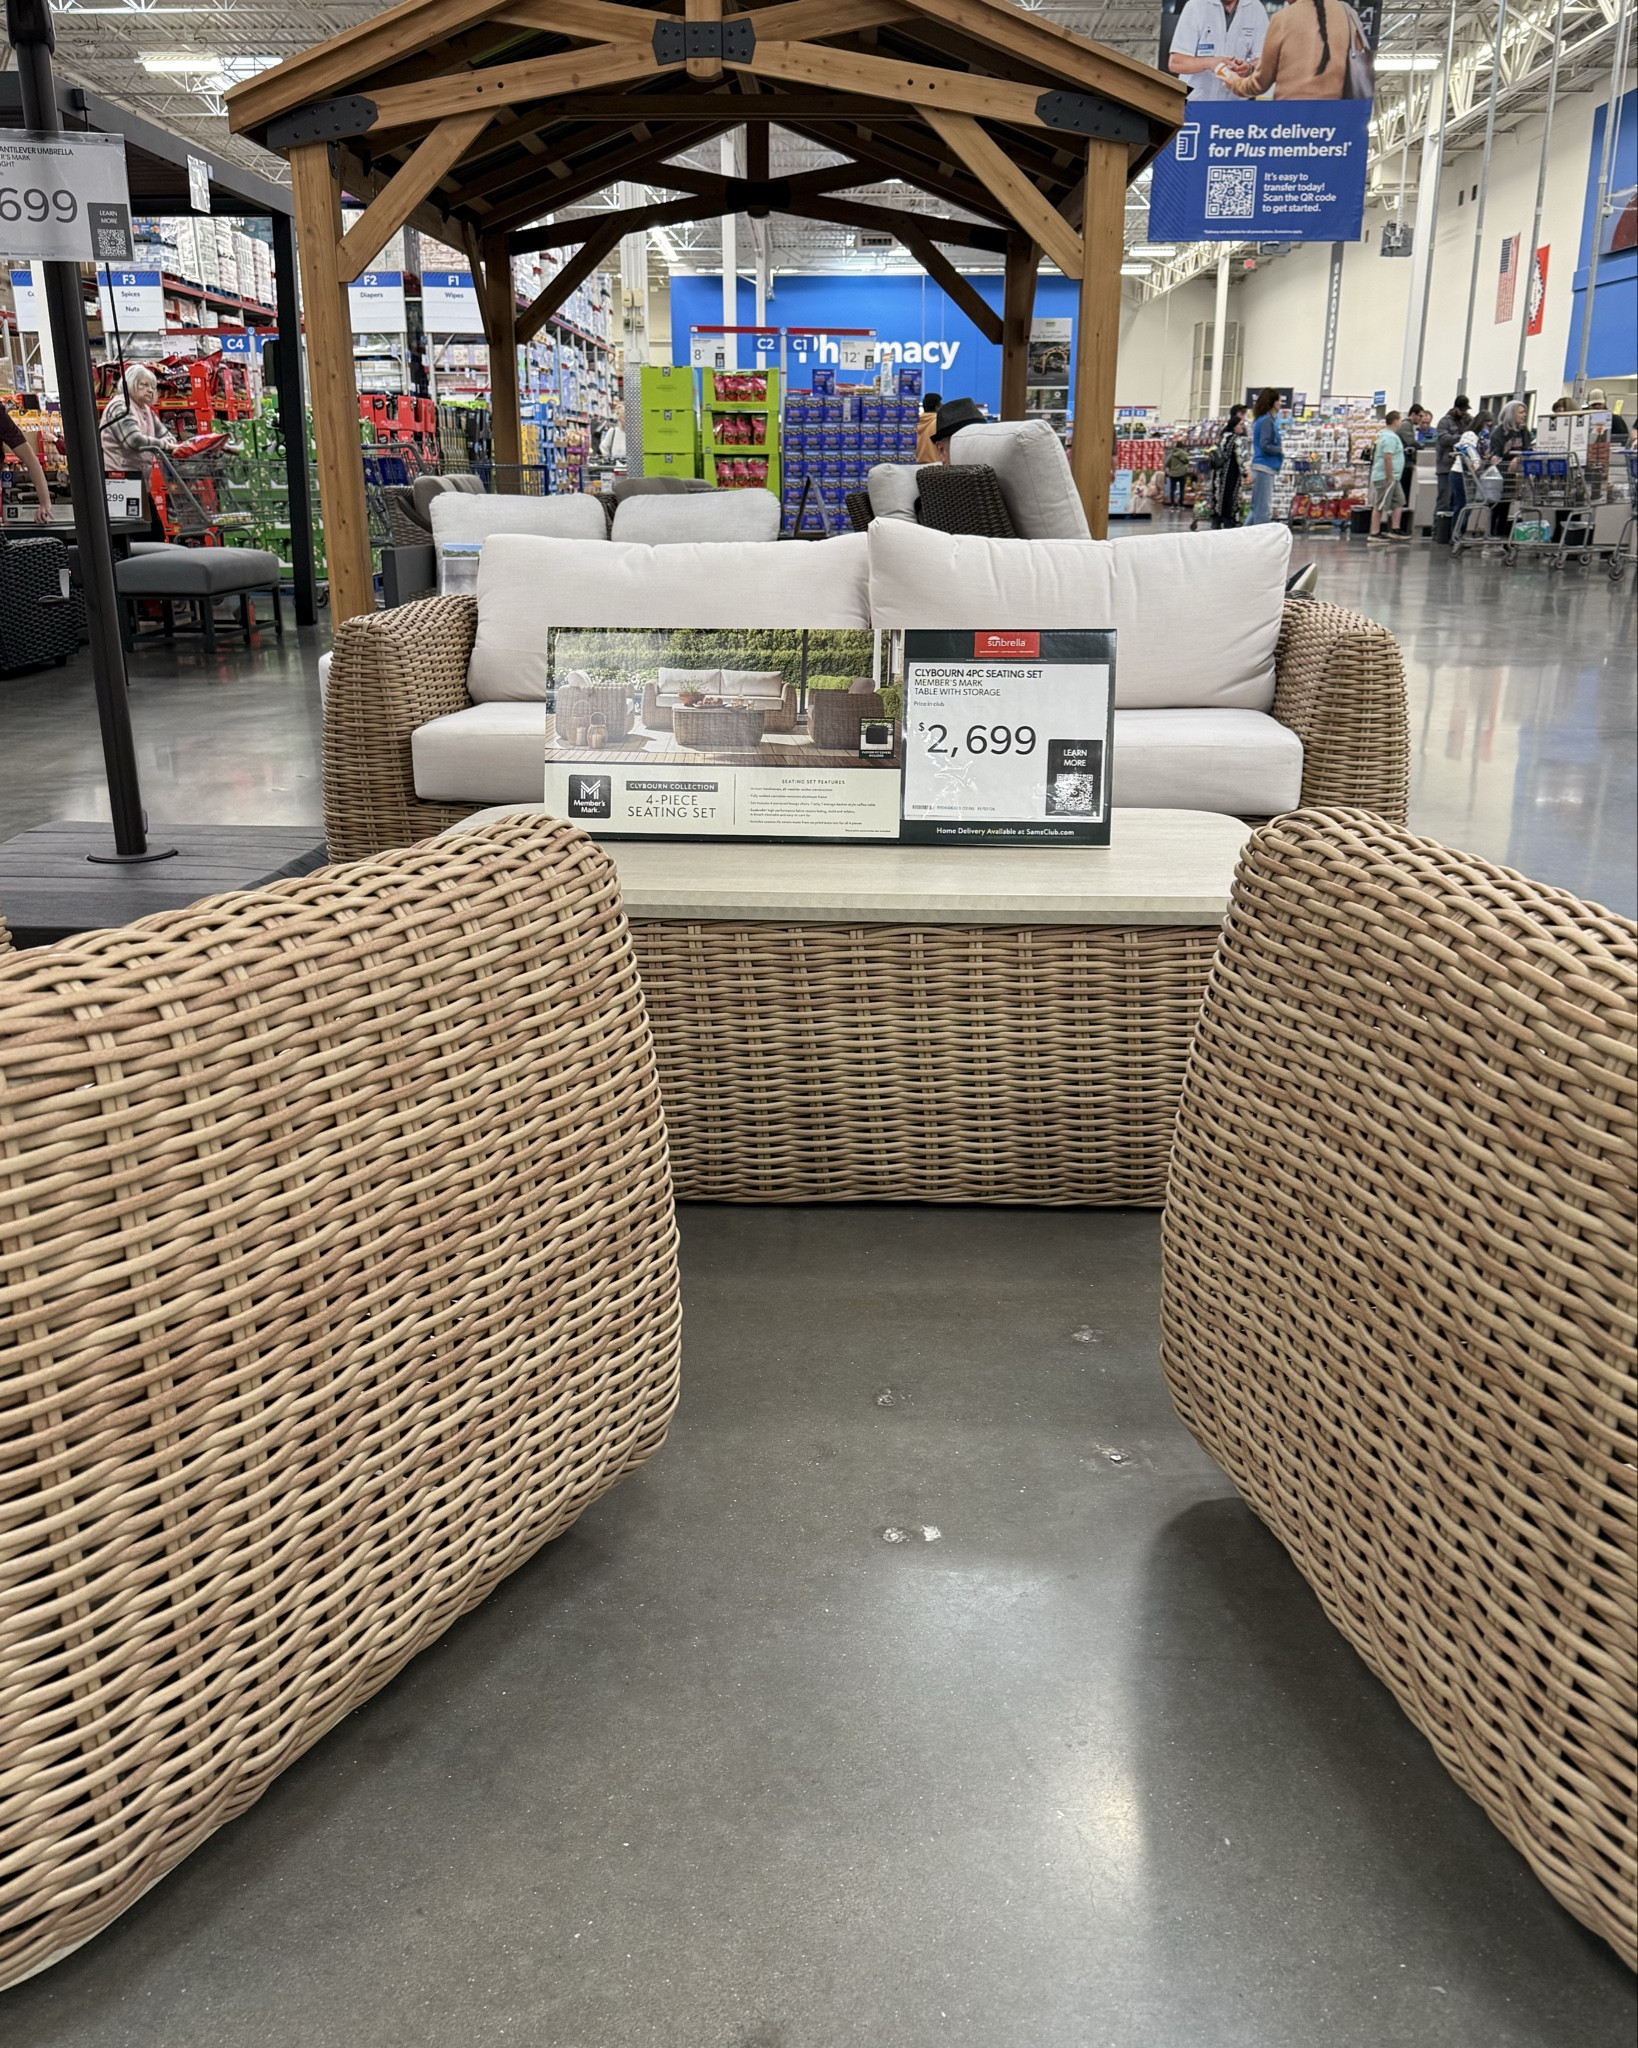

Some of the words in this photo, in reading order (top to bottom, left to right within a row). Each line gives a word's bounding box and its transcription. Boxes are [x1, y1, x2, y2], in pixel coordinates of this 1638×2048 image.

[1210, 124, 1245, 139] Free
[1248, 124, 1268, 139] Rx
[1271, 124, 1336, 142] delivery
[37, 147, 74, 156] UMBRELLA
[1208, 143, 1232, 158] for
[1234, 143, 1266, 158] Plus
[1264, 172, 1278, 181] It's
[1278, 174, 1298, 183] easy
[1299, 173, 1308, 181] to
[1263, 183, 1296, 192] transfer
[1298, 183, 1325, 193] today!
[1262, 194, 1284, 202] Scan
[1284, 194, 1300, 202] the
[1300, 194, 1314, 202] QR
[1314, 194, 1336, 202] code
[1262, 204, 1272, 212] to
[1272, 204, 1288, 214] get
[1288, 204, 1322, 212] started.
[122, 274, 136, 285] F3
[364, 275, 378, 286] F2
[448, 275, 460, 286] F1
[226, 338, 244, 350] C4
[757, 339, 774, 350] C2
[792, 338, 808, 350] C1
[987, 636, 1026, 647] sunbrella
[914, 668, 965, 678] CLYBOURN
[966, 669, 984, 678] 4PC
[986, 670, 1025, 679] SEATING
[1026, 670, 1044, 679] SET
[914, 678, 958, 687] MEMBER'S
[958, 679, 983, 687] MARK
[914, 688, 938, 696] TABLE
[939, 688, 962, 696] WITH
[962, 688, 1001, 696] STORAGE
[1063, 748, 1088, 757] LEARN
[1063, 759, 1087, 768] MORE
[646, 794, 698, 806] 4-PIECE
[628, 806, 688, 818] SEATING
[693, 808, 716, 818] SET
[936, 827, 957, 835] Home
[958, 828, 986, 836] Delivery
[986, 828, 1016, 836] Available
[1017, 828, 1025, 836] at
[1026, 828, 1075, 836] SamsClub.com
